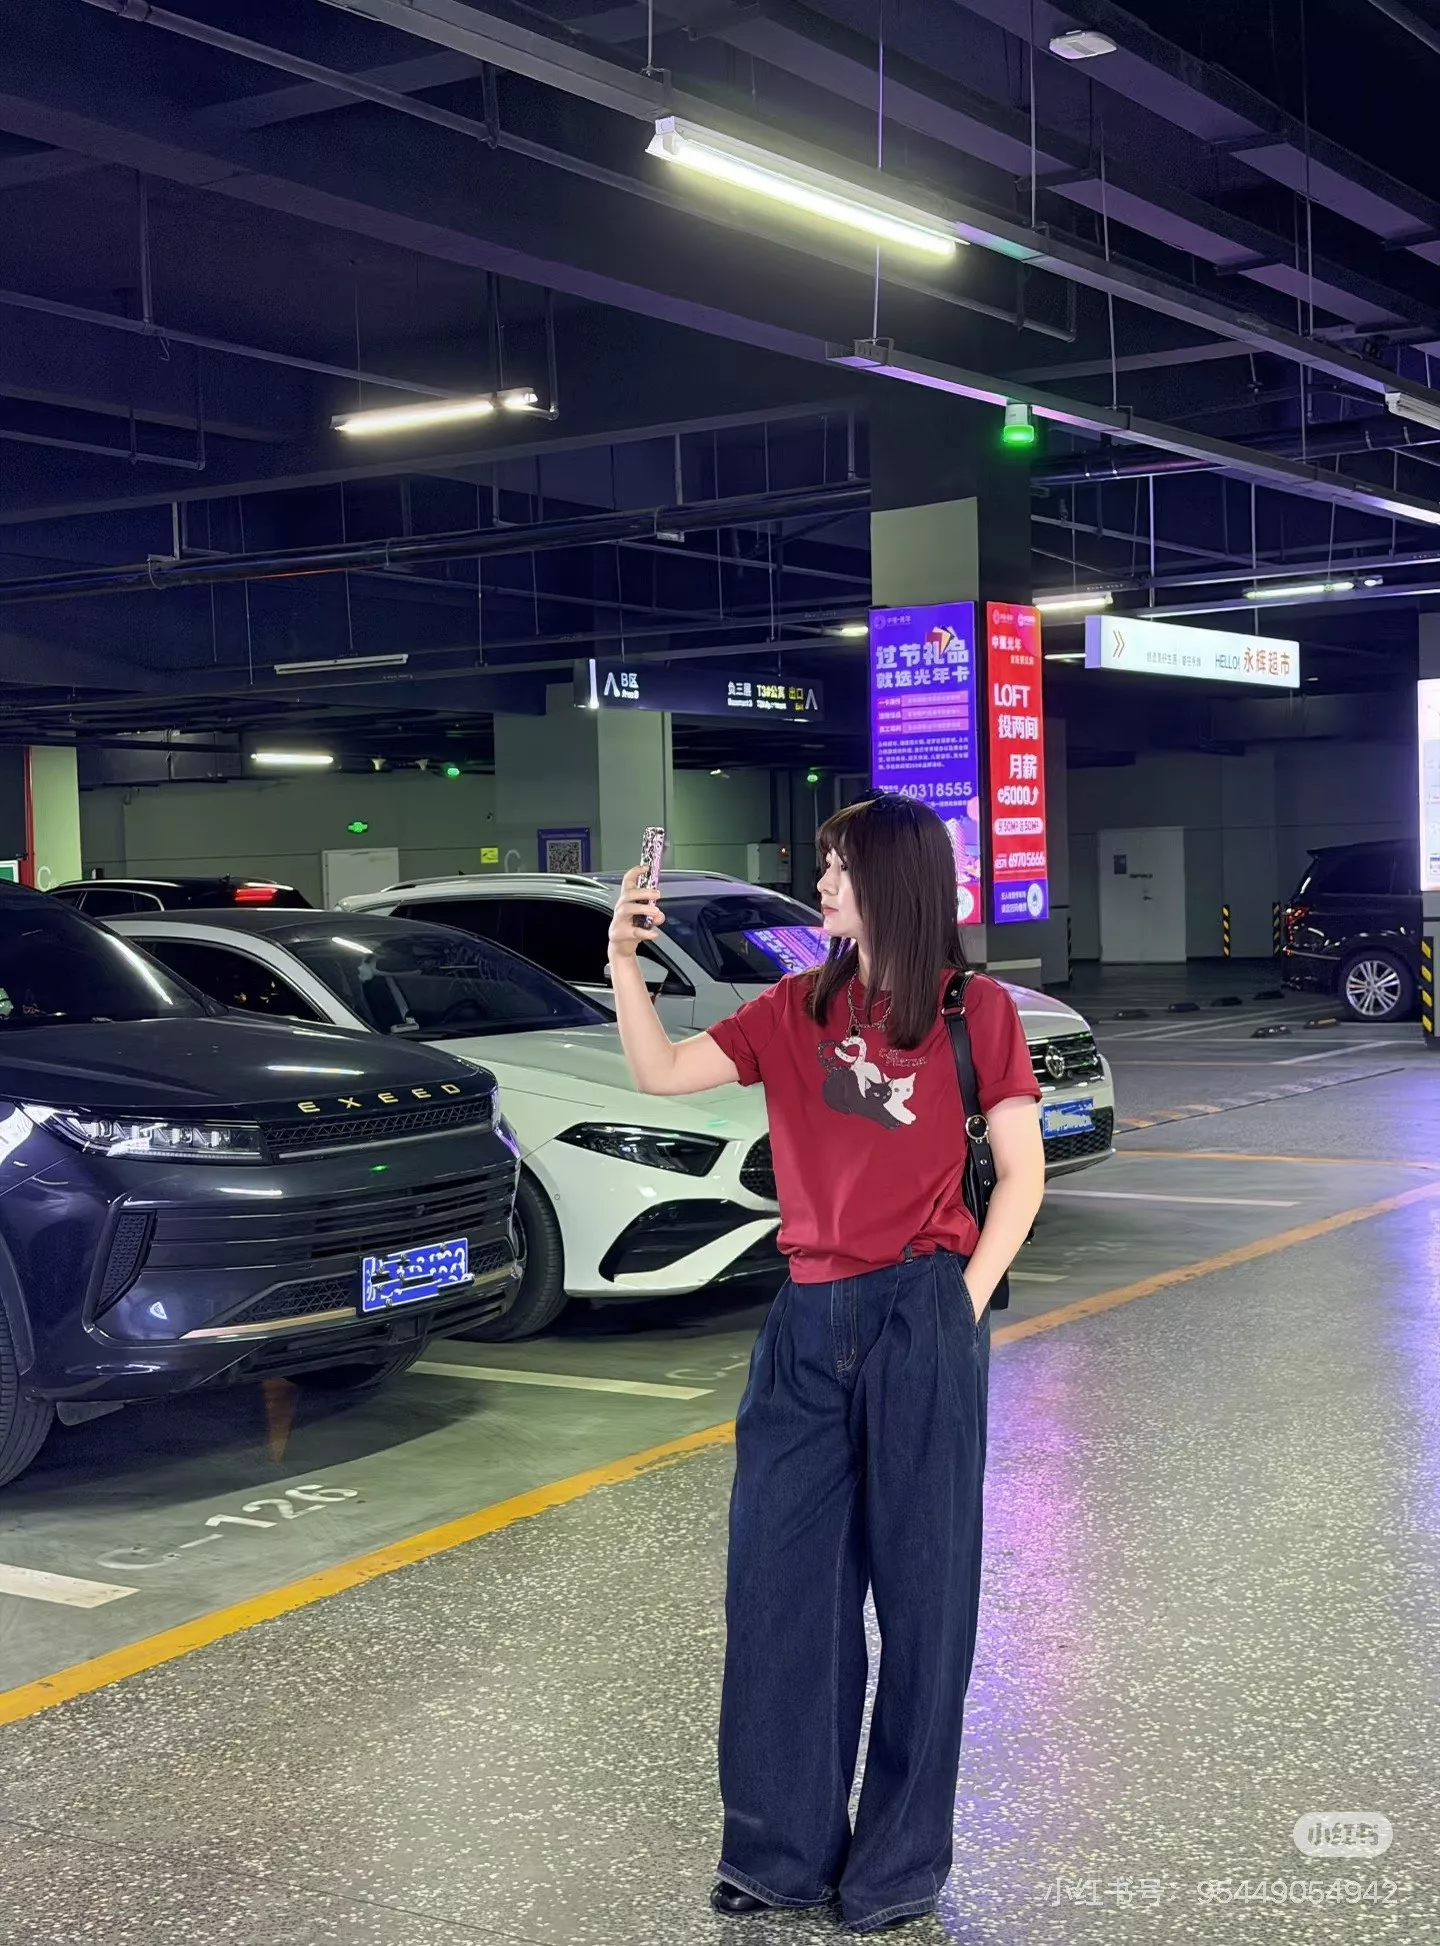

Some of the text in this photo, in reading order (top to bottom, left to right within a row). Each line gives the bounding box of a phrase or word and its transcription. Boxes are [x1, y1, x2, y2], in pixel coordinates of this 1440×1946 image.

[876, 640, 969, 669] 过节礼品
[1243, 647, 1290, 676] 永辉超市
[621, 673, 639, 688] B区
[789, 687, 803, 700] 出口
[993, 683, 1031, 708] LOFT
[998, 714, 1038, 739] 投两间
[1009, 753, 1038, 780] 月薪
[900, 781, 973, 798] 60318555
[298, 1084, 461, 1113] EXEED
